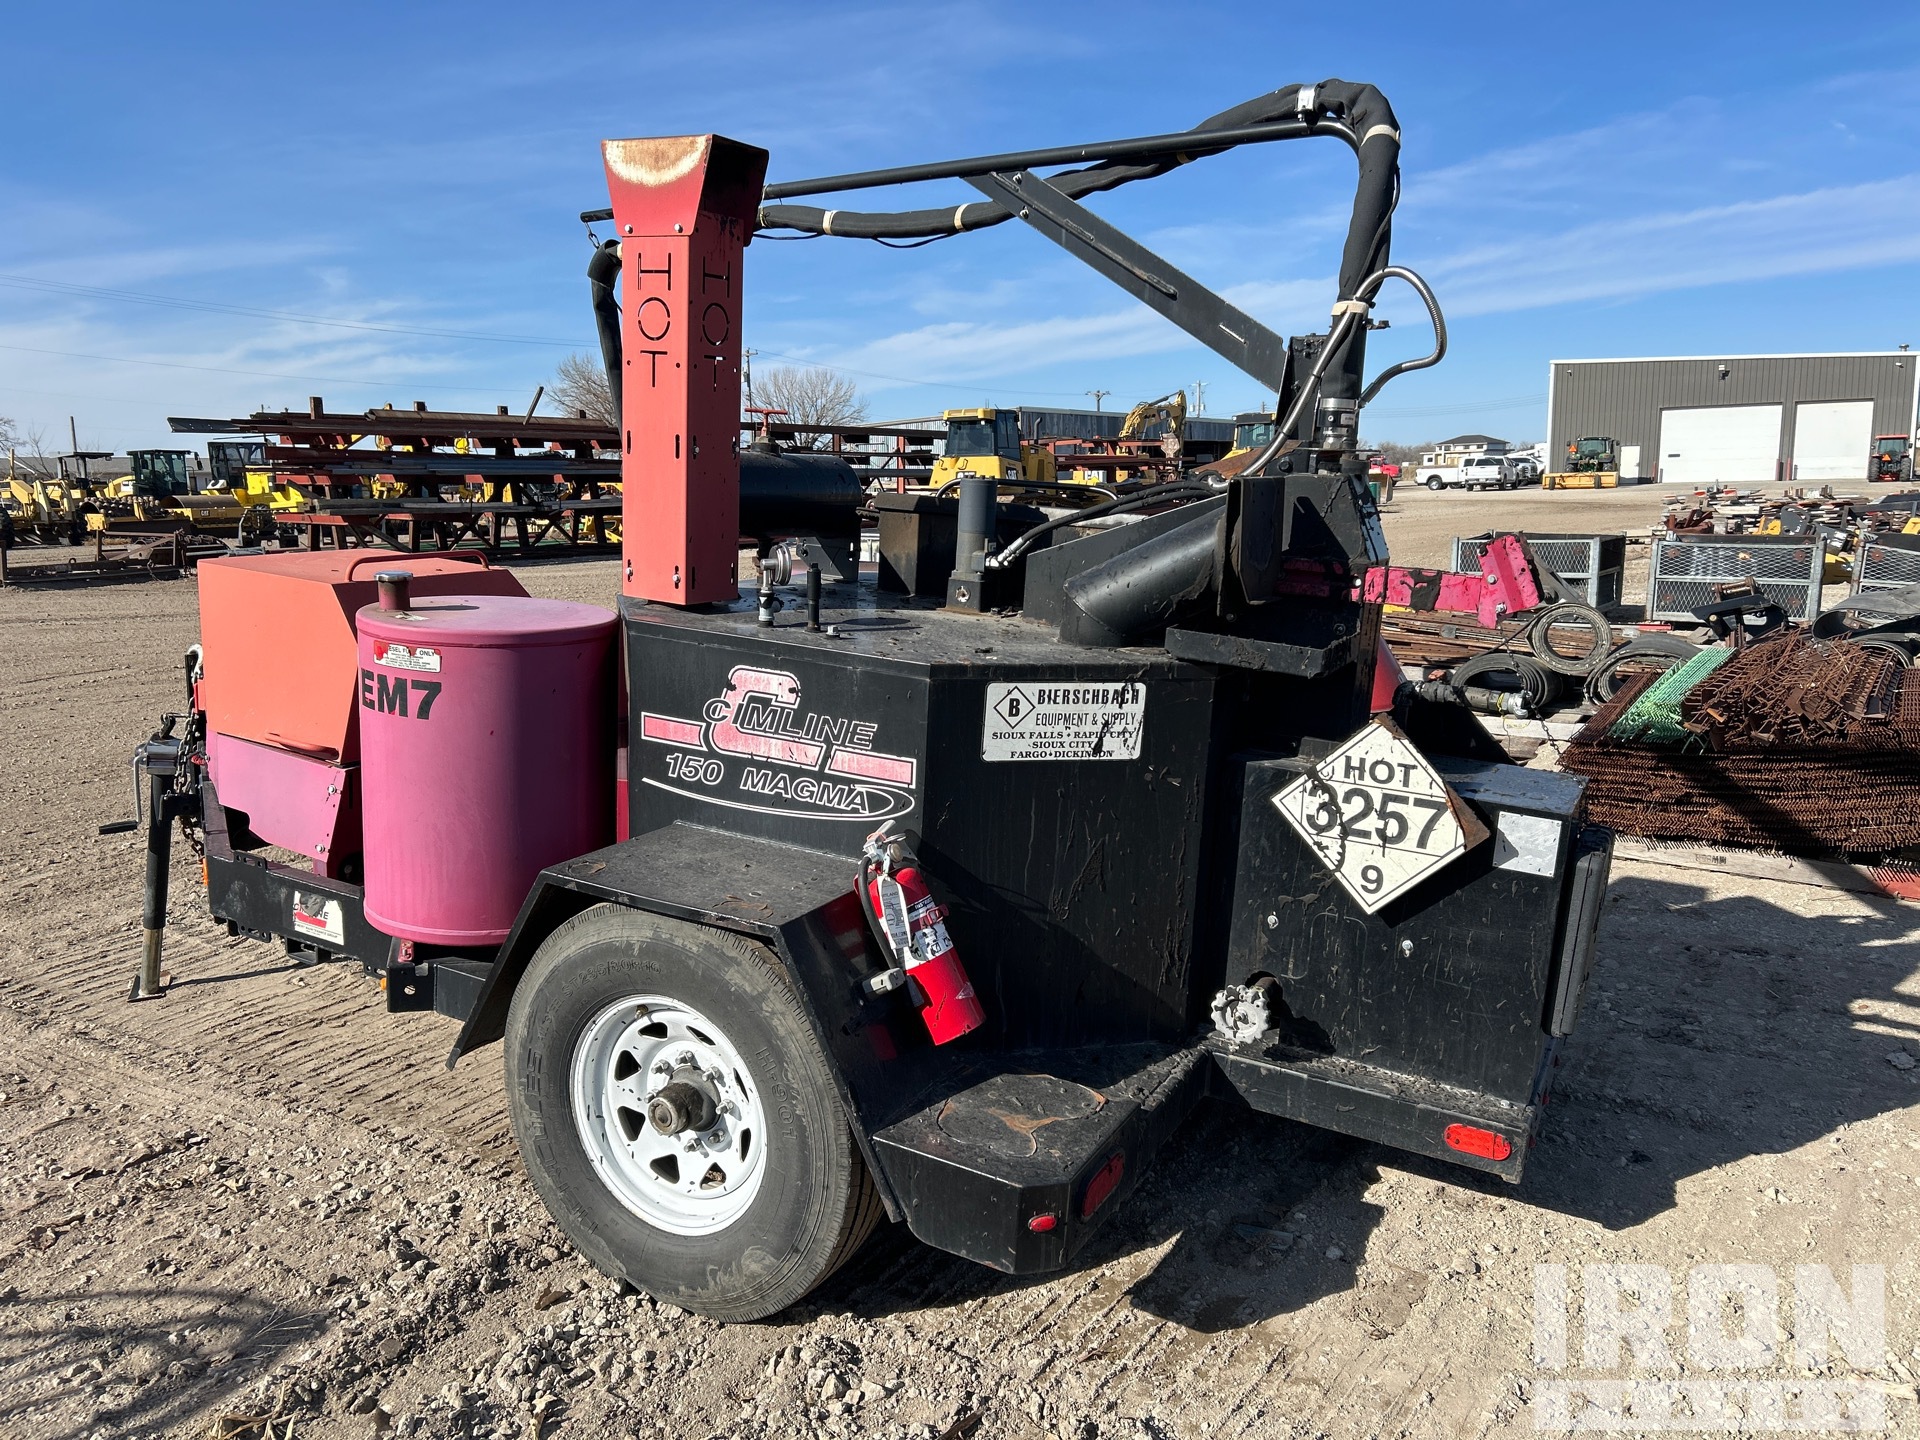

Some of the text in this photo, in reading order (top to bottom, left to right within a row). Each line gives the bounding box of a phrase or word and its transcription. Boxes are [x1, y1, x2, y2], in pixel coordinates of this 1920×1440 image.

[637, 252, 671, 387] HOT
[702, 256, 731, 392] HOT
[361, 668, 442, 720] EM7
[1008, 689, 1140, 718] B BIERSCHBACH
[703, 698, 878, 750] CIMLINE
[992, 731, 1134, 740] SIOUX FALLS RAPID CITY
[1035, 713, 1137, 727] EQUIPMENT & SUPPLY
[1010, 750, 1114, 759] FARGO DICKINSON
[1031, 741, 1094, 749] SIOUX CITY
[665, 752, 870, 814] 150 MAGMA
[1343, 755, 1418, 788] HOT
[1306, 782, 1450, 851] 3257
[1360, 864, 1384, 894] 9
[755, 1047, 798, 1140] H-901
